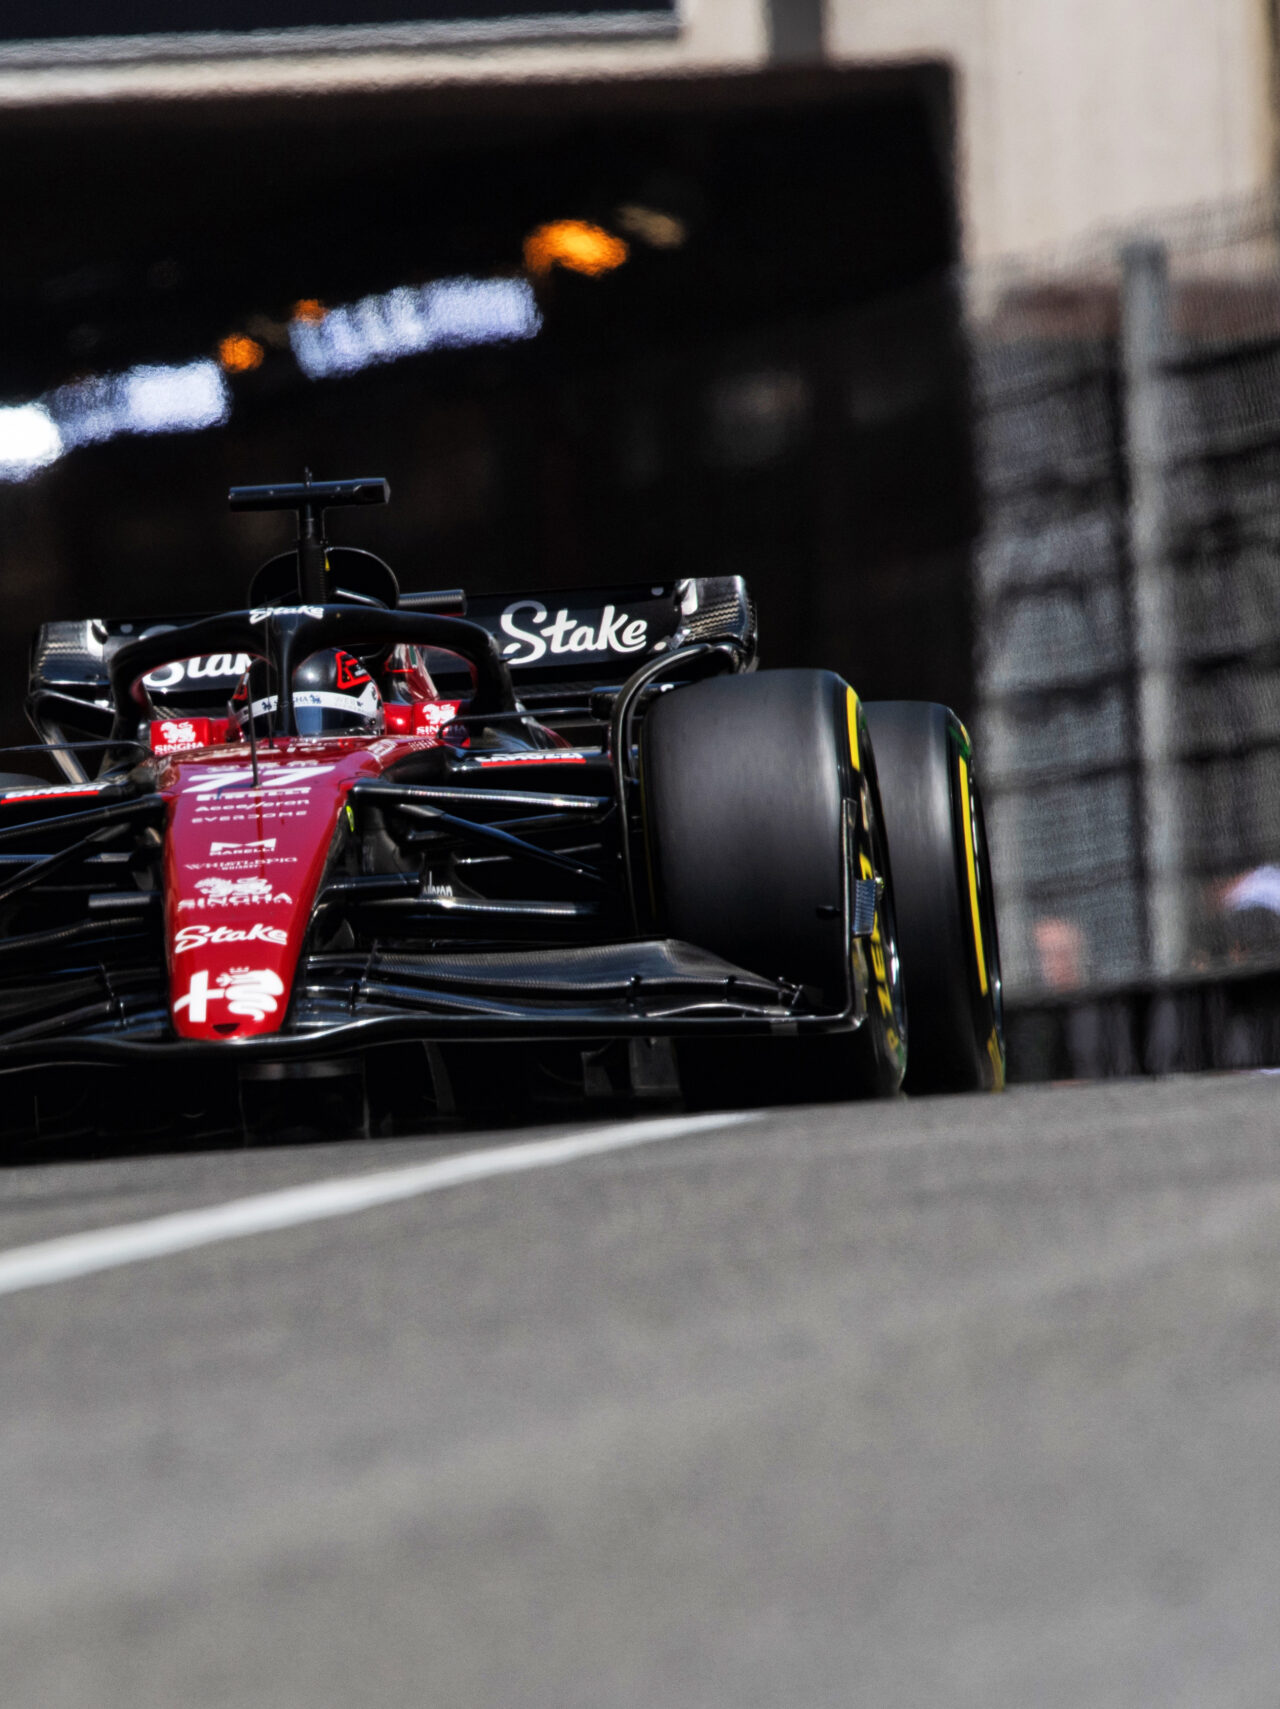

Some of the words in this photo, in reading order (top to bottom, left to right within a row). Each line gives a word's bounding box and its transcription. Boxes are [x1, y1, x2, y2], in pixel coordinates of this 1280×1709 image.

[500, 600, 648, 664] Stake
[154, 741, 205, 754] SINGHA
[182, 766, 335, 793] 77
[192, 810, 308, 823] EVERDOME
[178, 892, 293, 910] SINGHA
[174, 923, 288, 954] Stake
